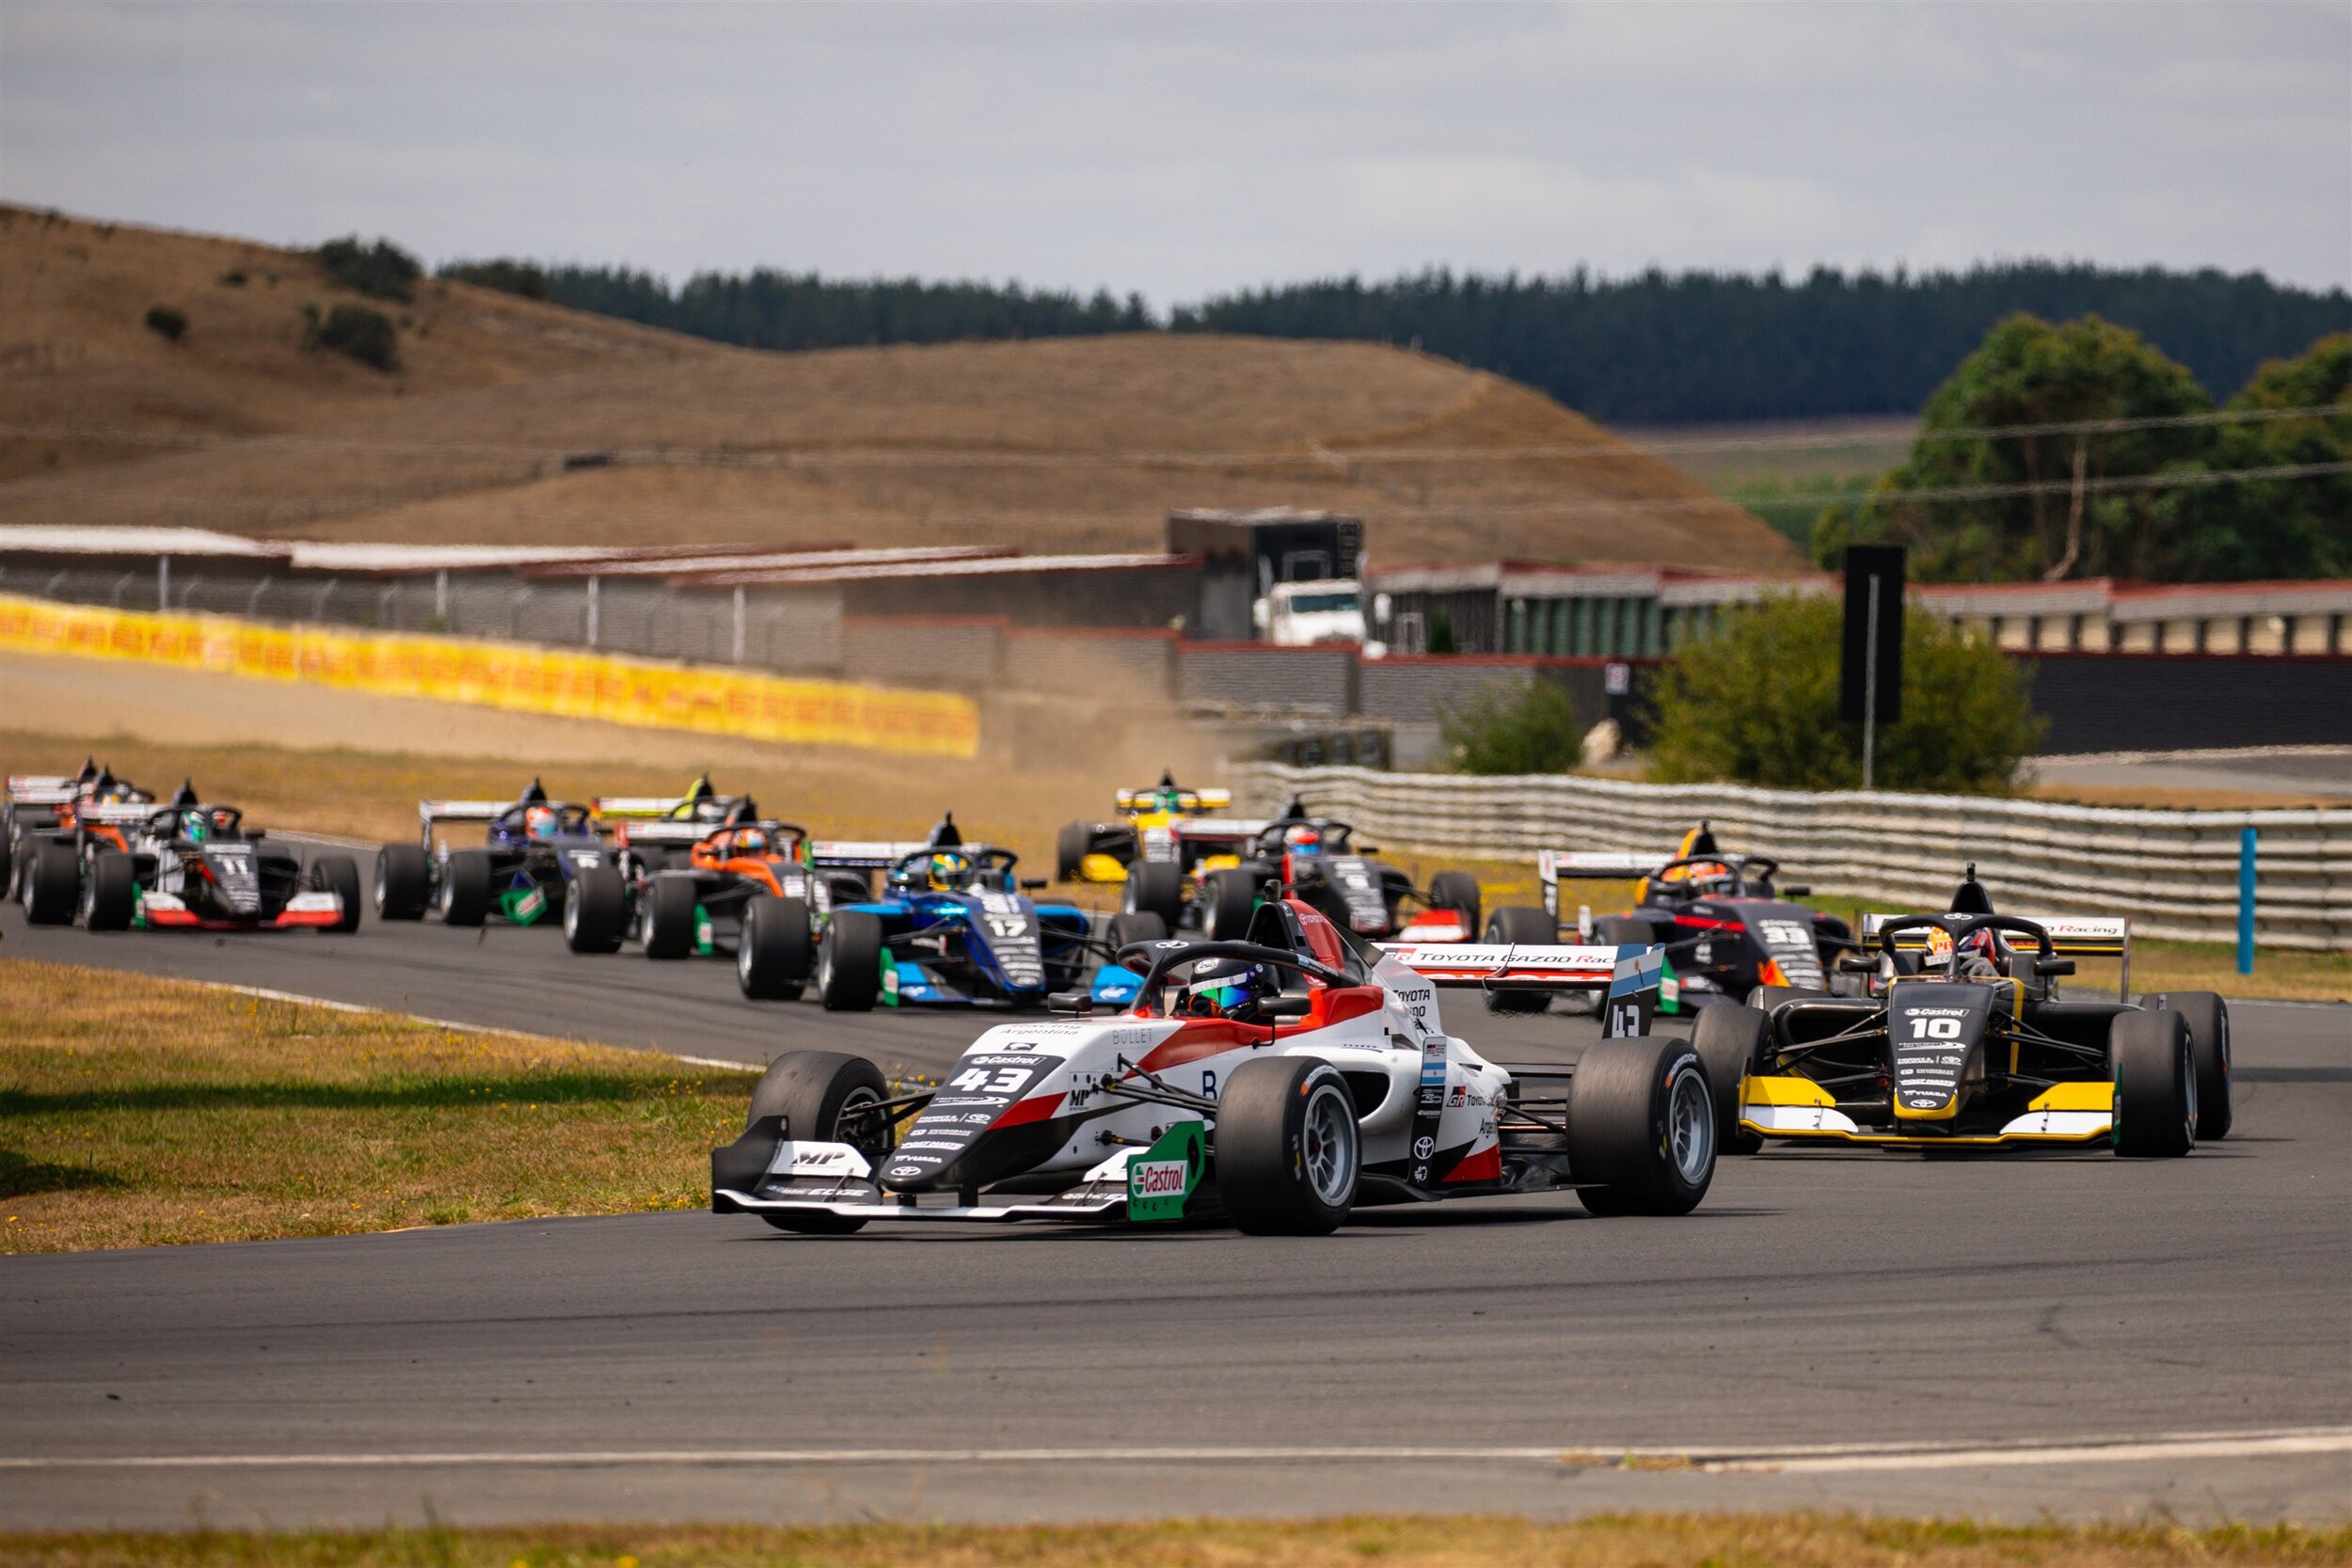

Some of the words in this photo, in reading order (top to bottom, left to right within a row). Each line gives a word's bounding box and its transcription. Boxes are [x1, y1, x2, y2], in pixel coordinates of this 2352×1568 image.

[221, 858, 248, 875] 11
[988, 920, 1027, 937] 17
[2058, 926, 2119, 935] Racing
[1419, 953, 1495, 962] TOYOTA
[1500, 954, 1572, 963] GAZOO
[1920, 1007, 1964, 1017] Castrol
[1909, 1018, 1963, 1039] 10
[988, 1055, 1039, 1065] Castrol
[949, 1068, 1034, 1094] 43
[1449, 1095, 1466, 1106] GR
[791, 1151, 846, 1164] MP
[1144, 1164, 1184, 1193] Castrol
